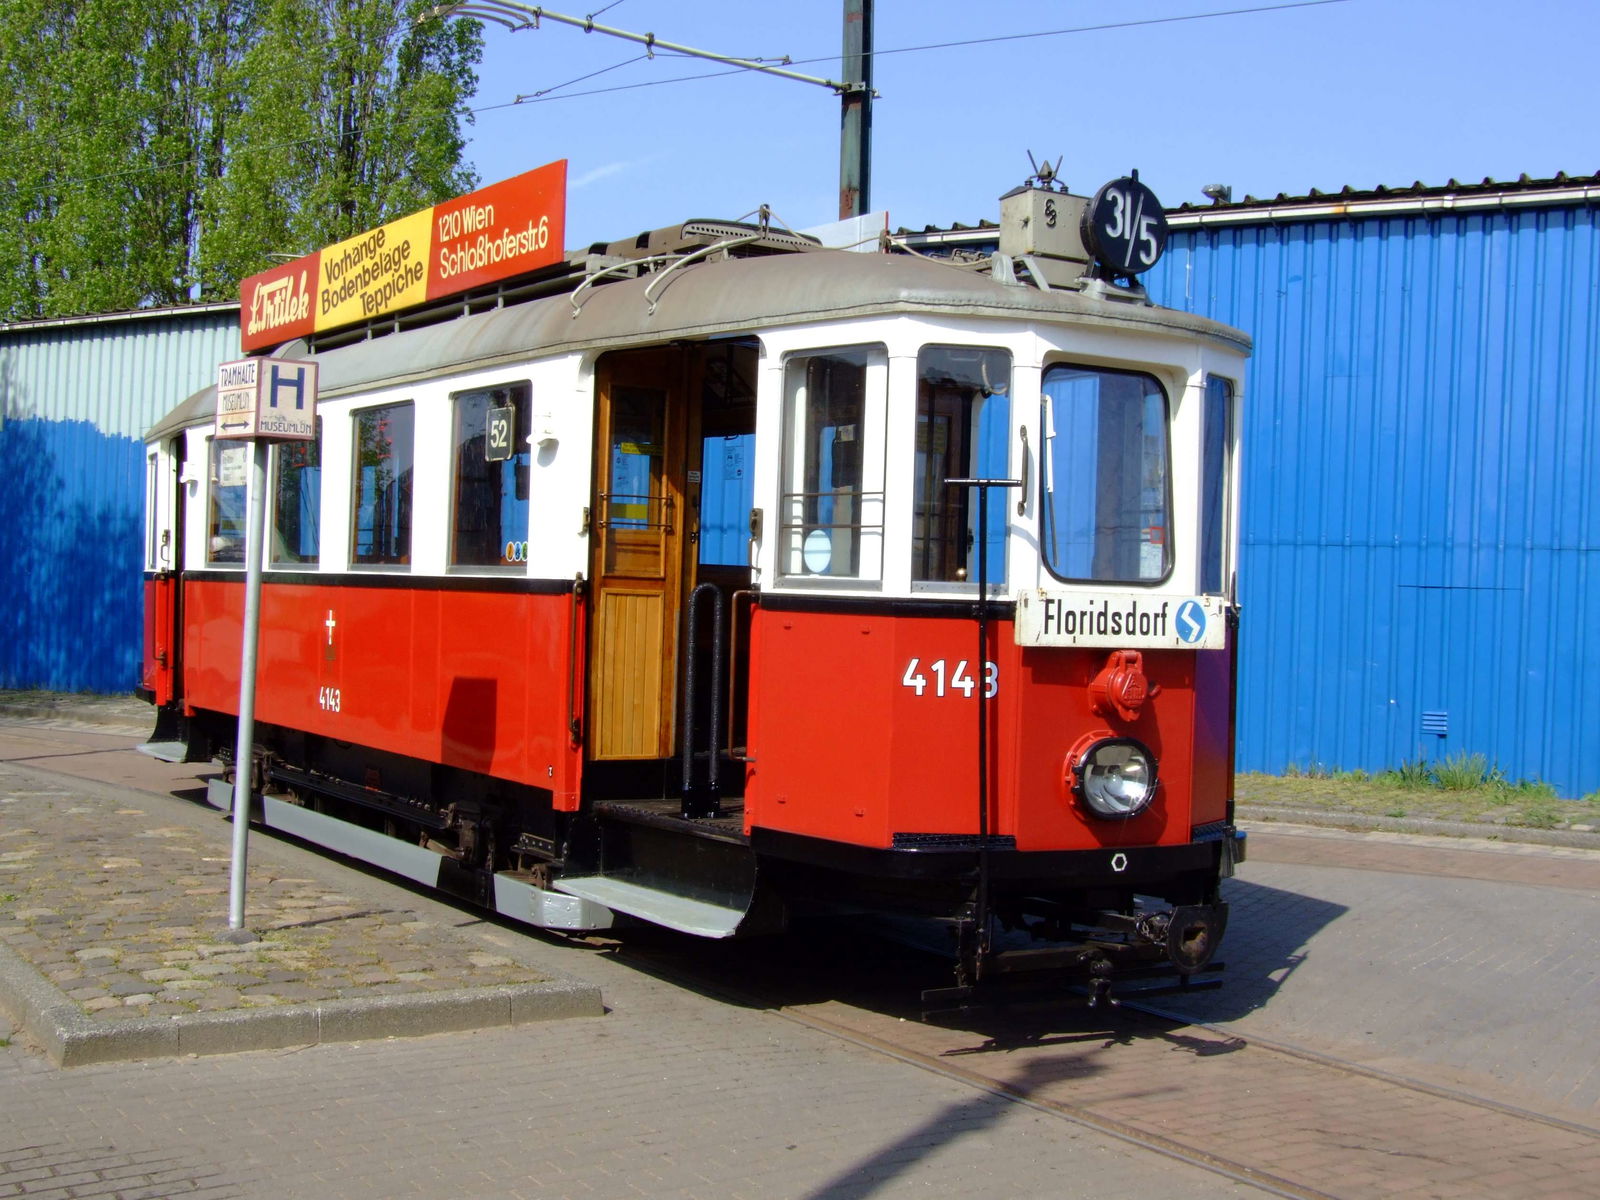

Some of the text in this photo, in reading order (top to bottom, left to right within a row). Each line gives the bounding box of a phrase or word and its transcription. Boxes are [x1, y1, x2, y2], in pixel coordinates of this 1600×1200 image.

[439, 204, 494, 243] 1210 Wien
[325, 228, 386, 285] Vorhänge
[321, 239, 411, 316] Bodenbeläge
[360, 261, 423, 316] Teppiche
[221, 363, 256, 388] TRAMHALTE
[270, 365, 305, 410] H
[490, 420, 507, 448] 52
[1044, 599, 1168, 636] Floridsdorf
[902, 658, 999, 699] 4143
[319, 686, 341, 712] 4143
